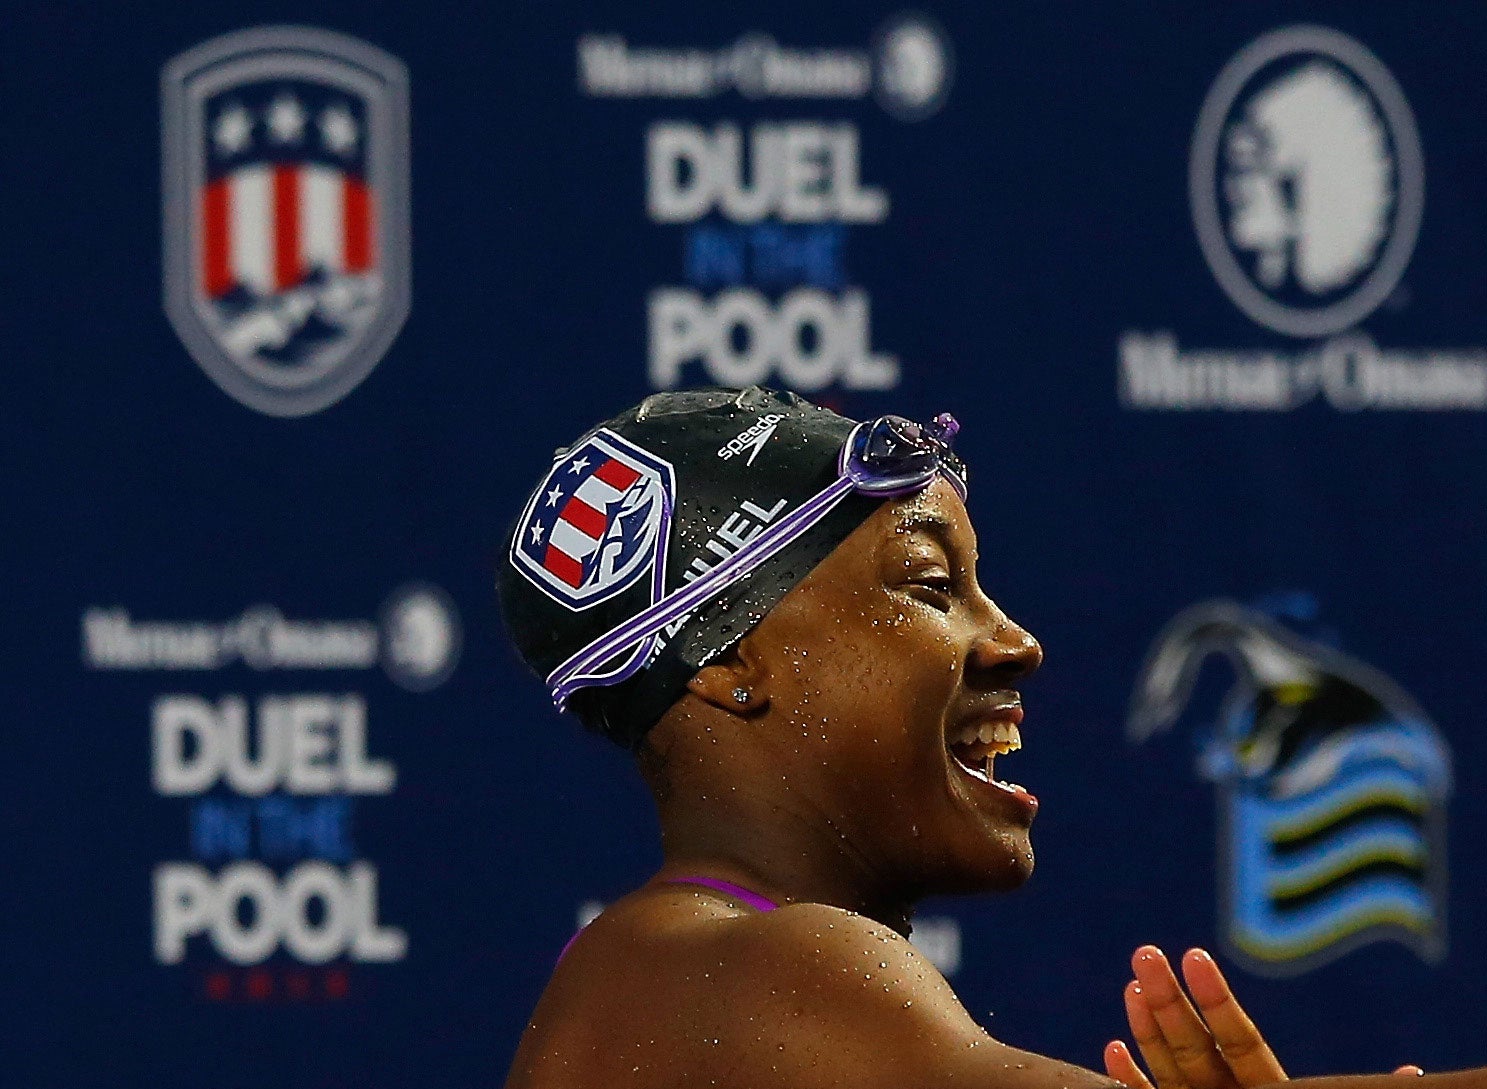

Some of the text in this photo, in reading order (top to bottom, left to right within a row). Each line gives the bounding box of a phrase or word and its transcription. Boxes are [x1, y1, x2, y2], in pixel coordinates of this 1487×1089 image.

[648, 122, 889, 222] DUEL
[648, 287, 898, 389] POOL
[717, 414, 781, 461] speedo
[153, 694, 396, 796] DUEL
[153, 861, 408, 966] POOL
